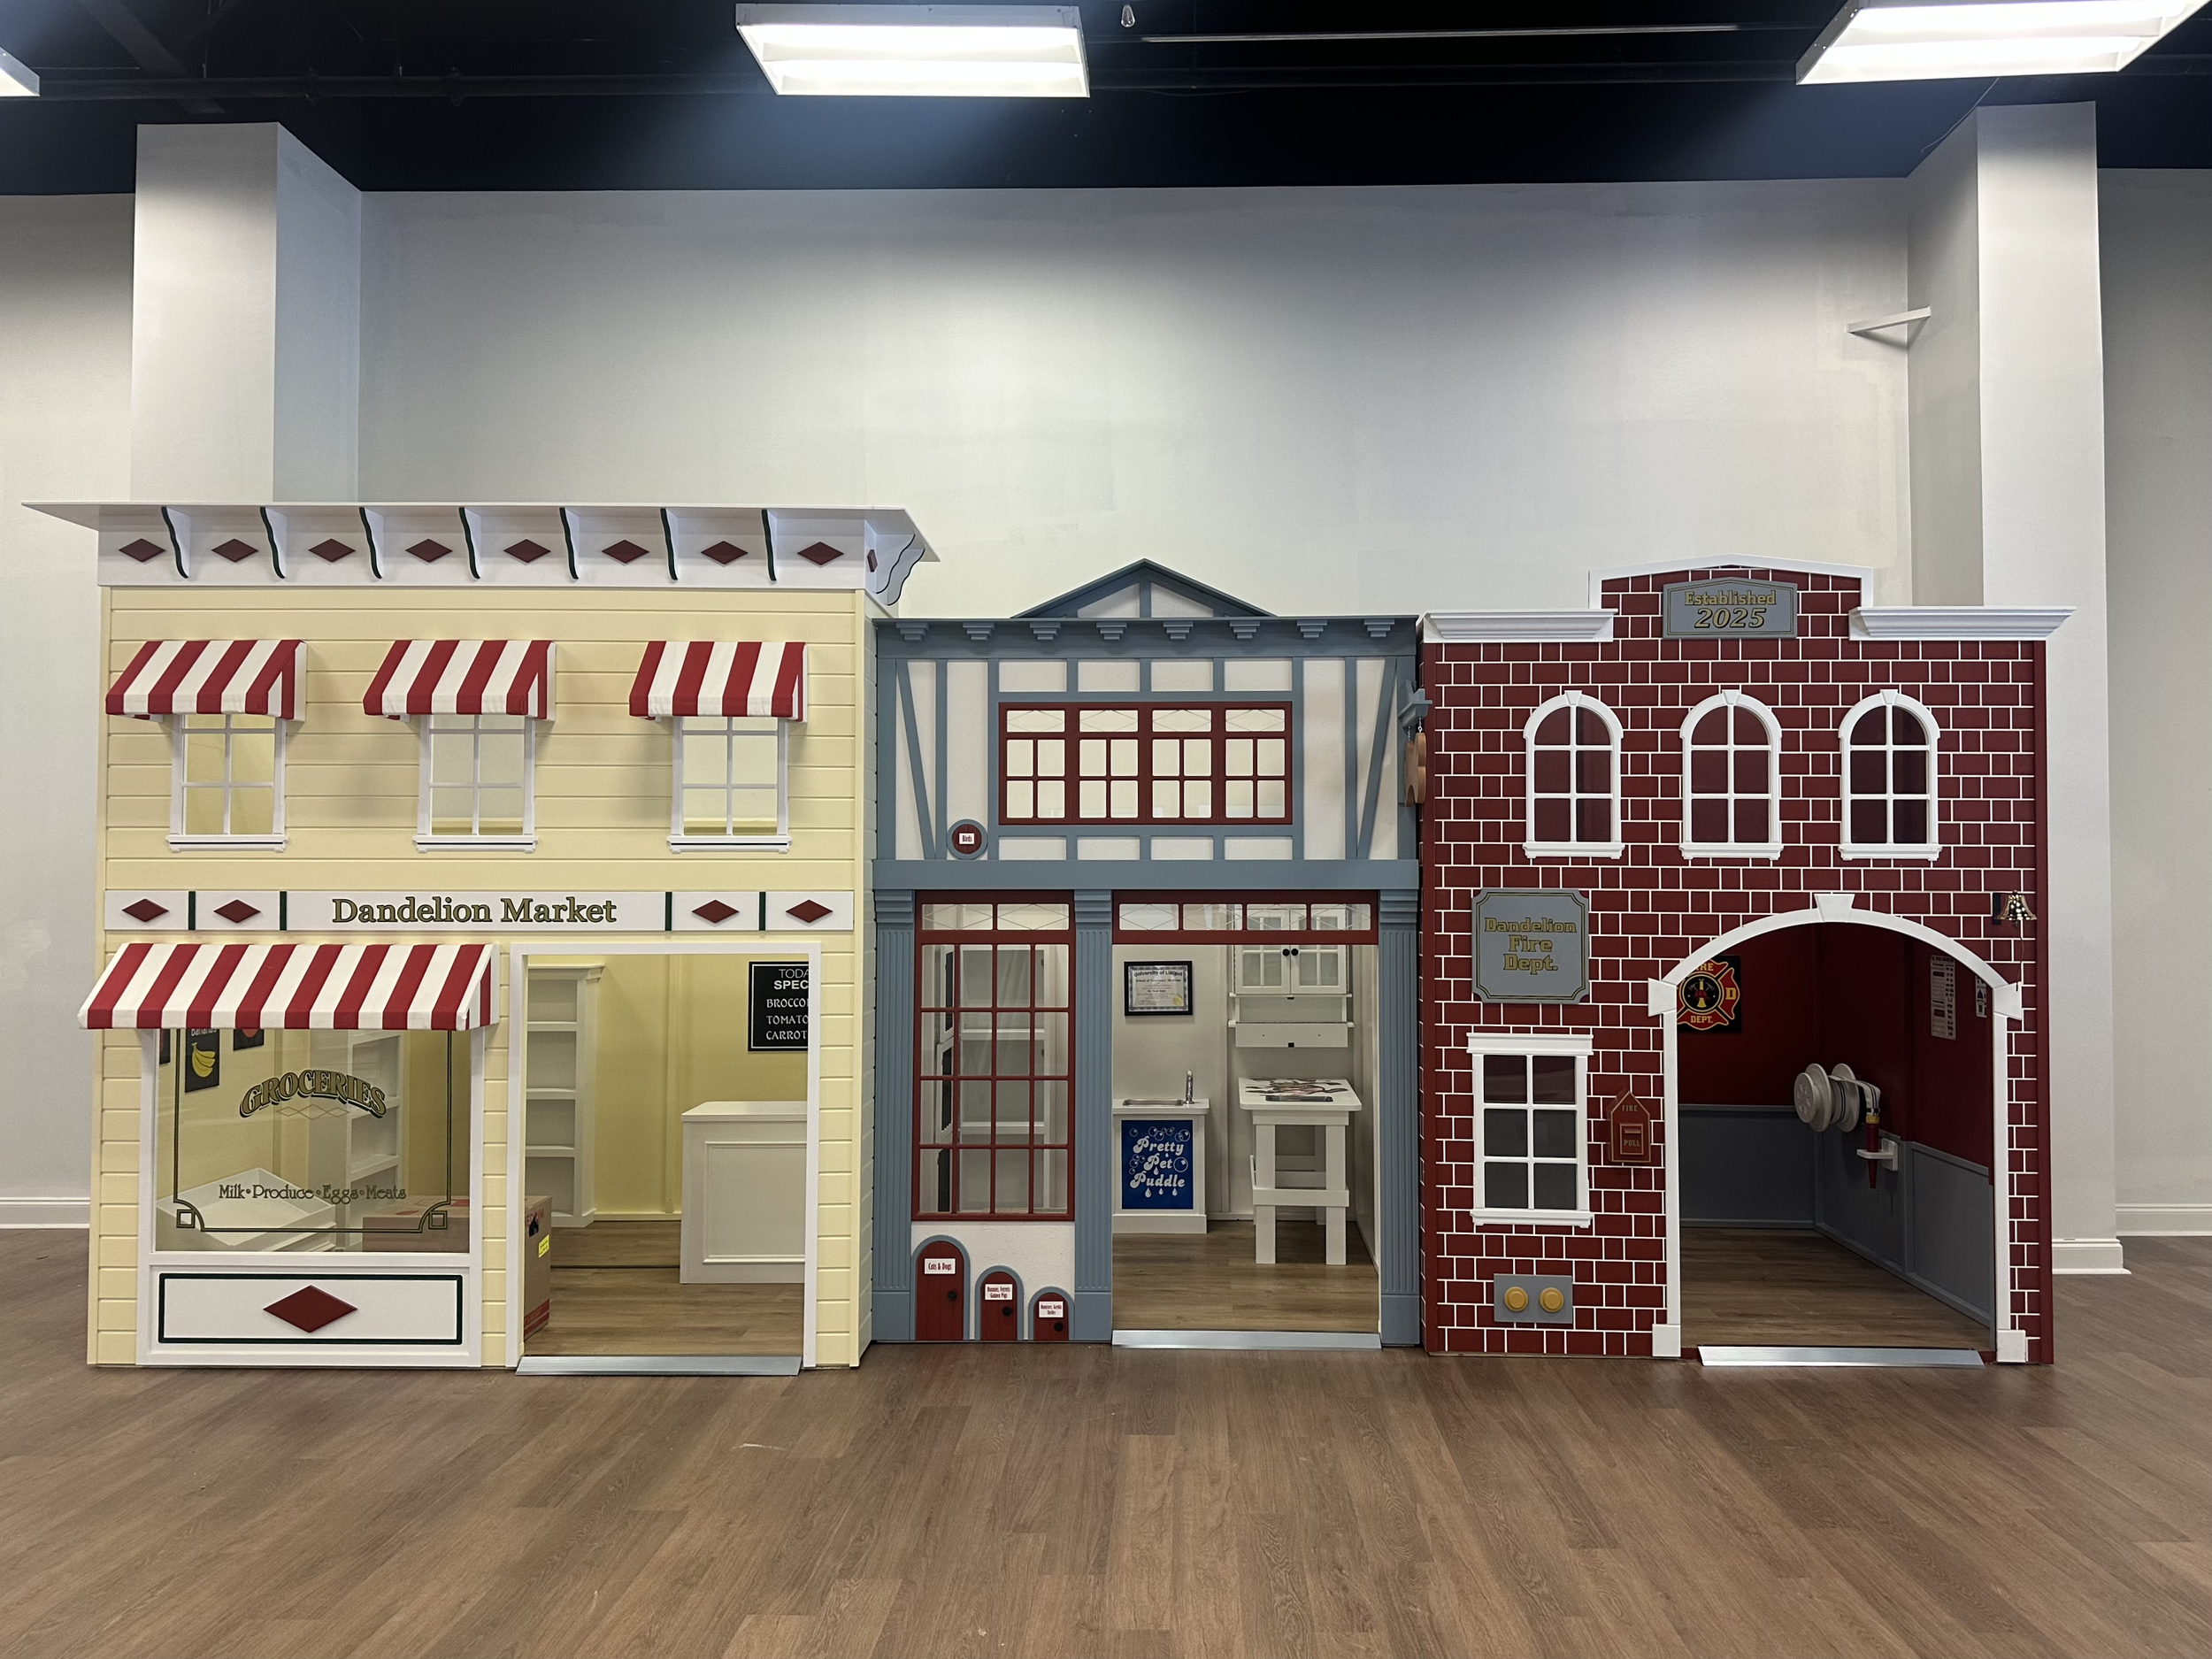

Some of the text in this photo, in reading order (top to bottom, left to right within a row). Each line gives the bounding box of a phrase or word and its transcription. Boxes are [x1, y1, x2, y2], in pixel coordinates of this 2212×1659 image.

[1685, 590, 1777, 606] Established
[1694, 608, 1767, 628] 2025
[332, 896, 617, 923] Dandelion Market
[1484, 918, 1577, 933] Dandelion
[1509, 934, 1553, 952] Fire
[1503, 954, 1558, 975] Dept.
[1696, 963, 1715, 972] RE
[773, 979, 809, 990] SPEC
[1725, 987, 1737, 1000] D
[766, 1014, 809, 1025] TOMATO
[1690, 1015, 1713, 1024] DEPT.
[239, 1069, 387, 1118] GROCERIES
[1133, 1135, 1184, 1156] Pretty
[1143, 1152, 1173, 1171] Pet
[1129, 1171, 1186, 1188] Puddle
[219, 1184, 406, 1205] Milk Produce Eggs Meats
[941, 1262, 952, 1271] Dogs
